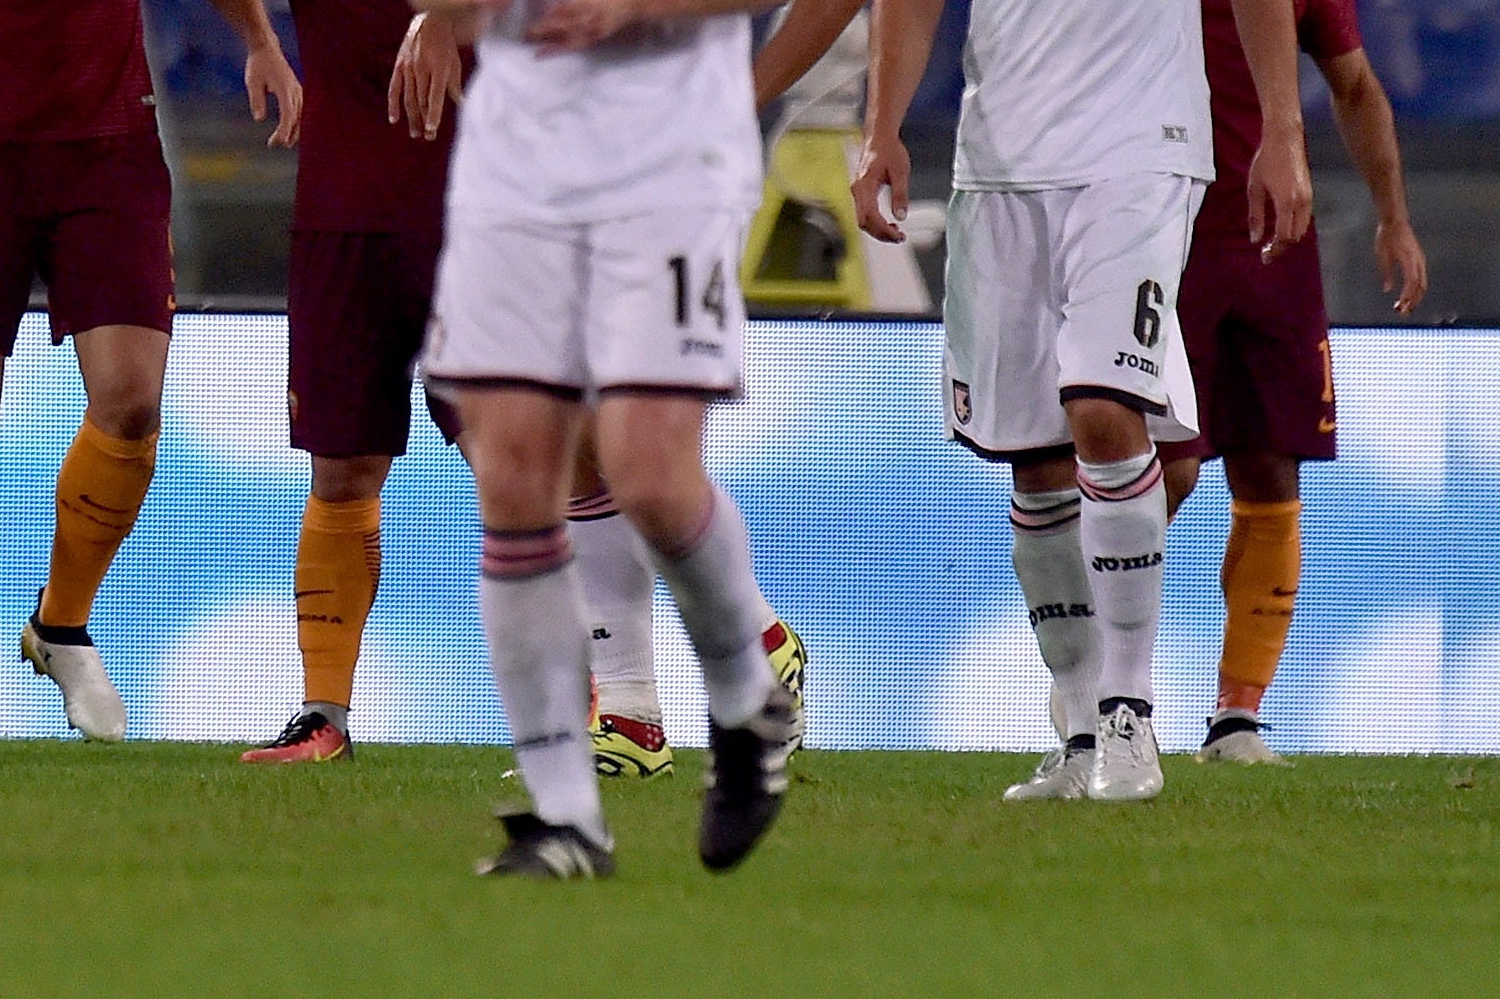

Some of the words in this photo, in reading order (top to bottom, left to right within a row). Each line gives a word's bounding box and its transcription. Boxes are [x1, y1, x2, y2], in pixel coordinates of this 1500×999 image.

[669, 255, 726, 330] 14
[1133, 279, 1164, 349] 6
[1114, 352, 1159, 378] Jom
